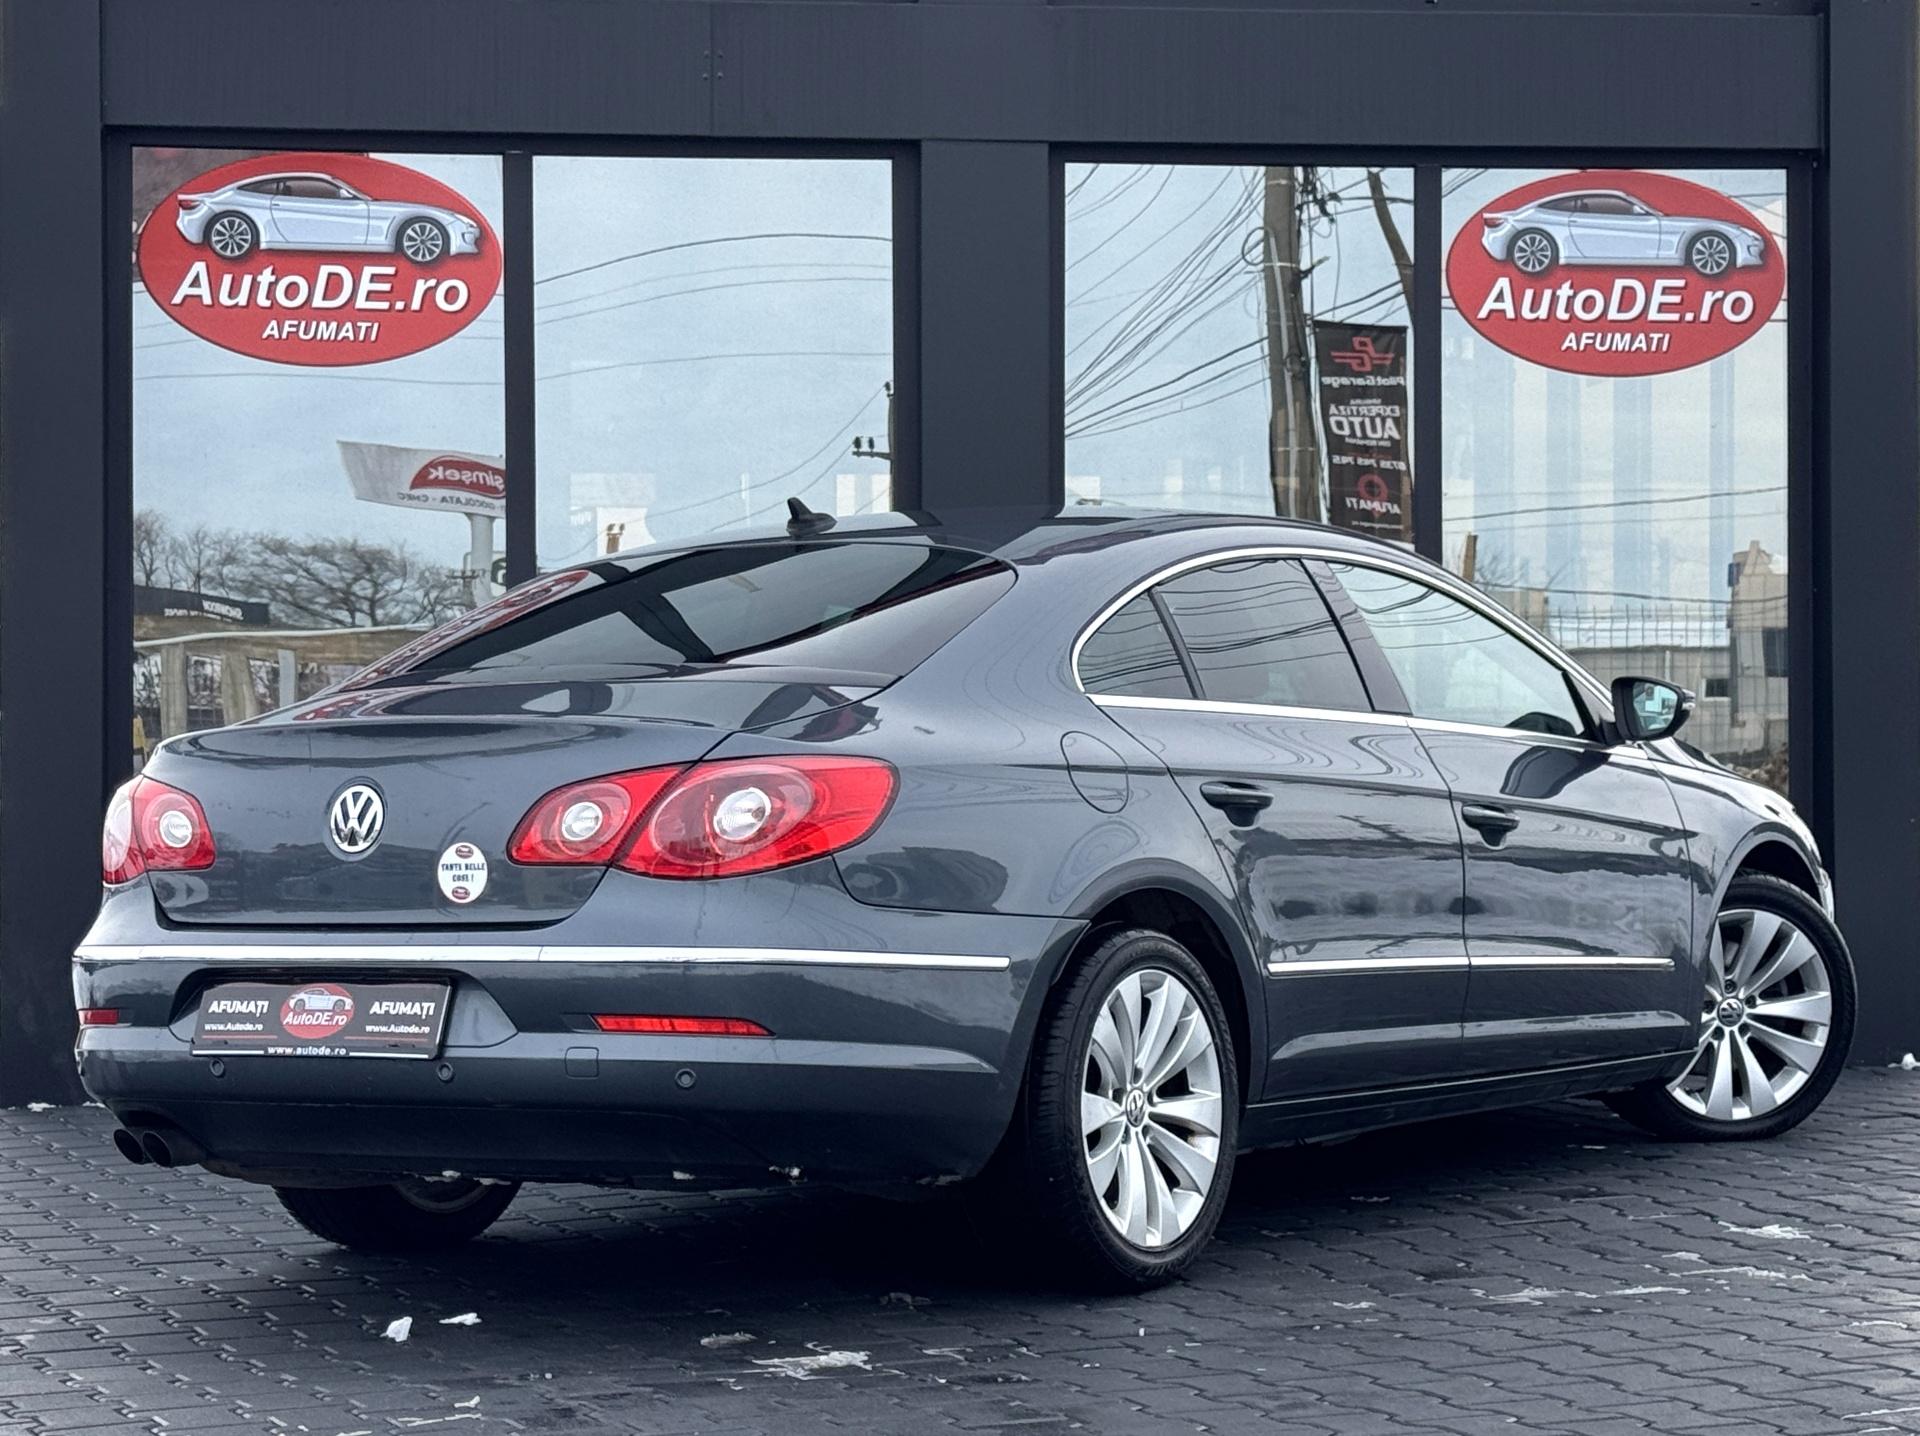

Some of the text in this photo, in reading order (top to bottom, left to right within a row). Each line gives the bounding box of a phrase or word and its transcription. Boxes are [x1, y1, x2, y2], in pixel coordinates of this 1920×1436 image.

[170, 260, 469, 313] AutoDE.ro
[1477, 276, 1755, 323] AutoDE.ro
[261, 319, 380, 342] AFUMATI
[1561, 332, 1671, 353] AFUMATI
[208, 1000, 269, 1018] AFUMAȚI
[283, 1011, 348, 1026] AutoDE.ro
[369, 1001, 436, 1019] AFUMAȚI
[267, 1045, 347, 1056] www.autode.ro
